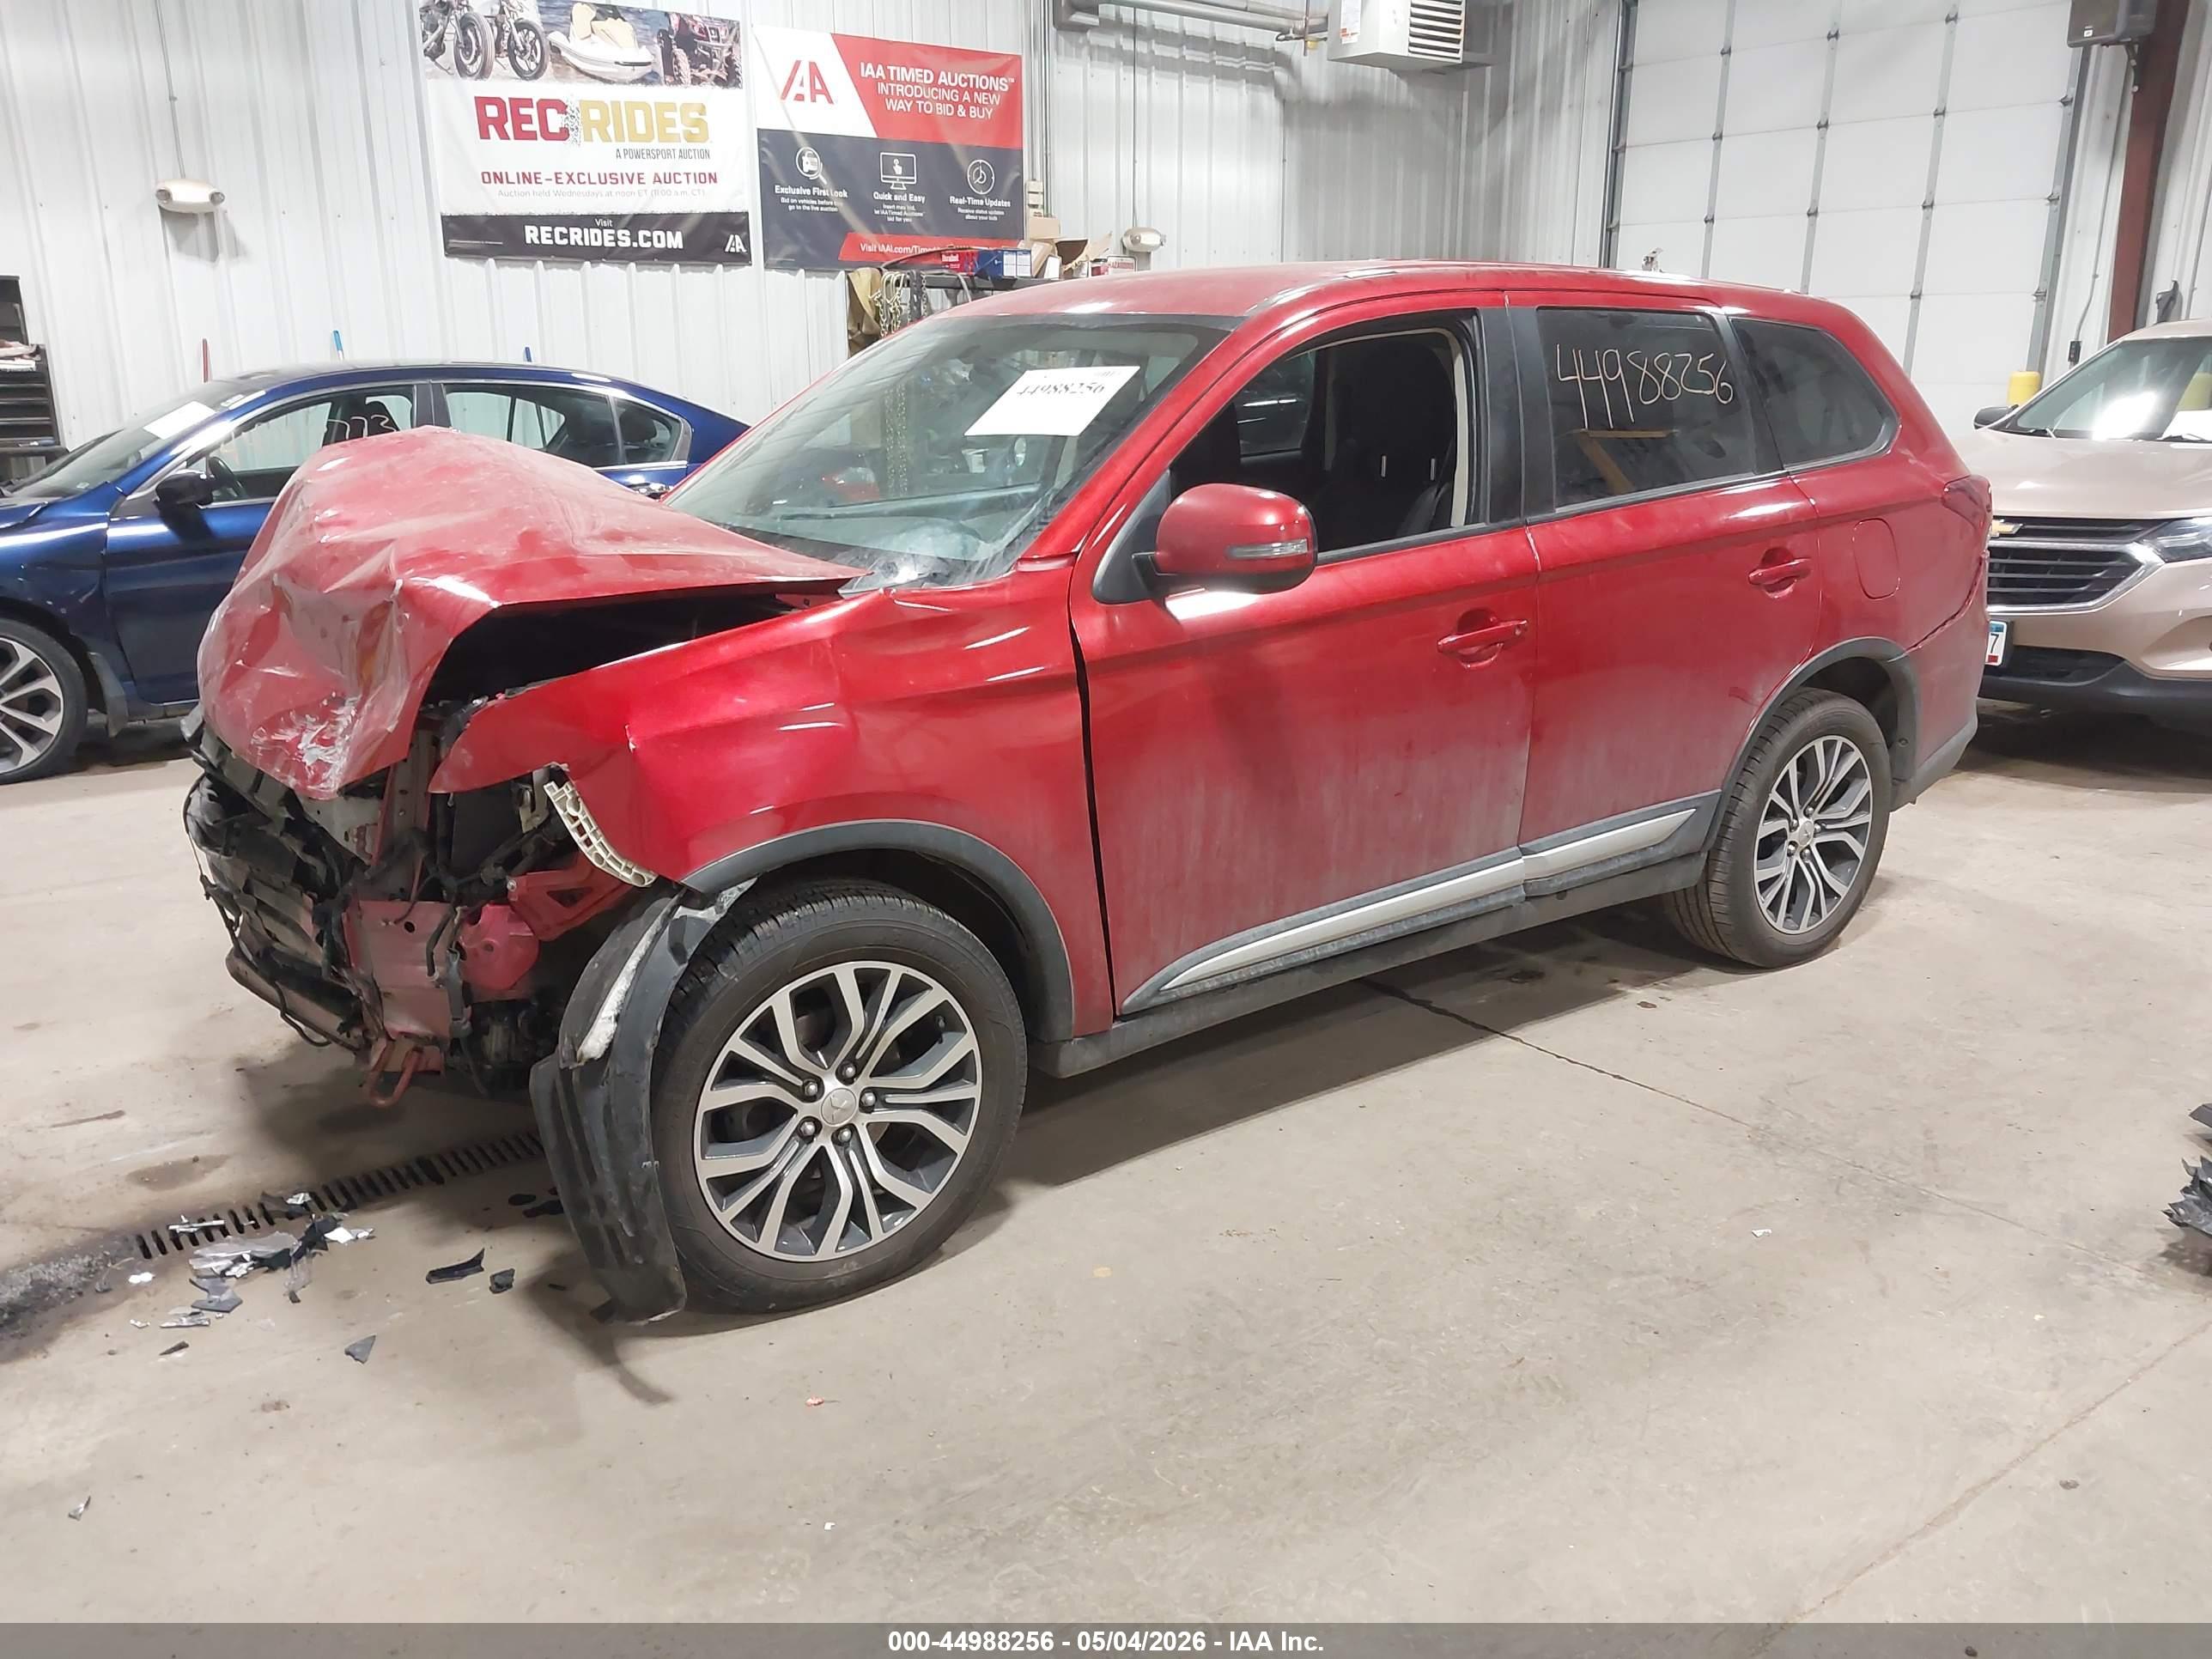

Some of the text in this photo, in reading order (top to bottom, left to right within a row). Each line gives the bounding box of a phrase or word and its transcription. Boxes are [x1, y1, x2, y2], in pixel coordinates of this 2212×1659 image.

[860, 61, 886, 80] IAA
[886, 65, 934, 84] TIMED
[878, 82, 1000, 106] INTRODUCING A NEW
[885, 98, 994, 119] WAY TO BID & BUY
[616, 149, 711, 161] A POWERSPORT AUCTION
[481, 171, 719, 185] ONLINE-EXCLUSIVE AUCTION
[497, 190, 531, 198] Auction
[532, 190, 550, 198] held
[554, 190, 604, 199] Wednesdays
[775, 185, 811, 196] Exclusive
[872, 191, 893, 201] Quick
[908, 193, 926, 204] Easy
[949, 195, 1012, 208] Real-Time Updates
[595, 218, 613, 228] Visit
[524, 225, 684, 249] RECRIDES.COM
[860, 242, 877, 252] Visit
[1556, 343, 1734, 429] 44988256
